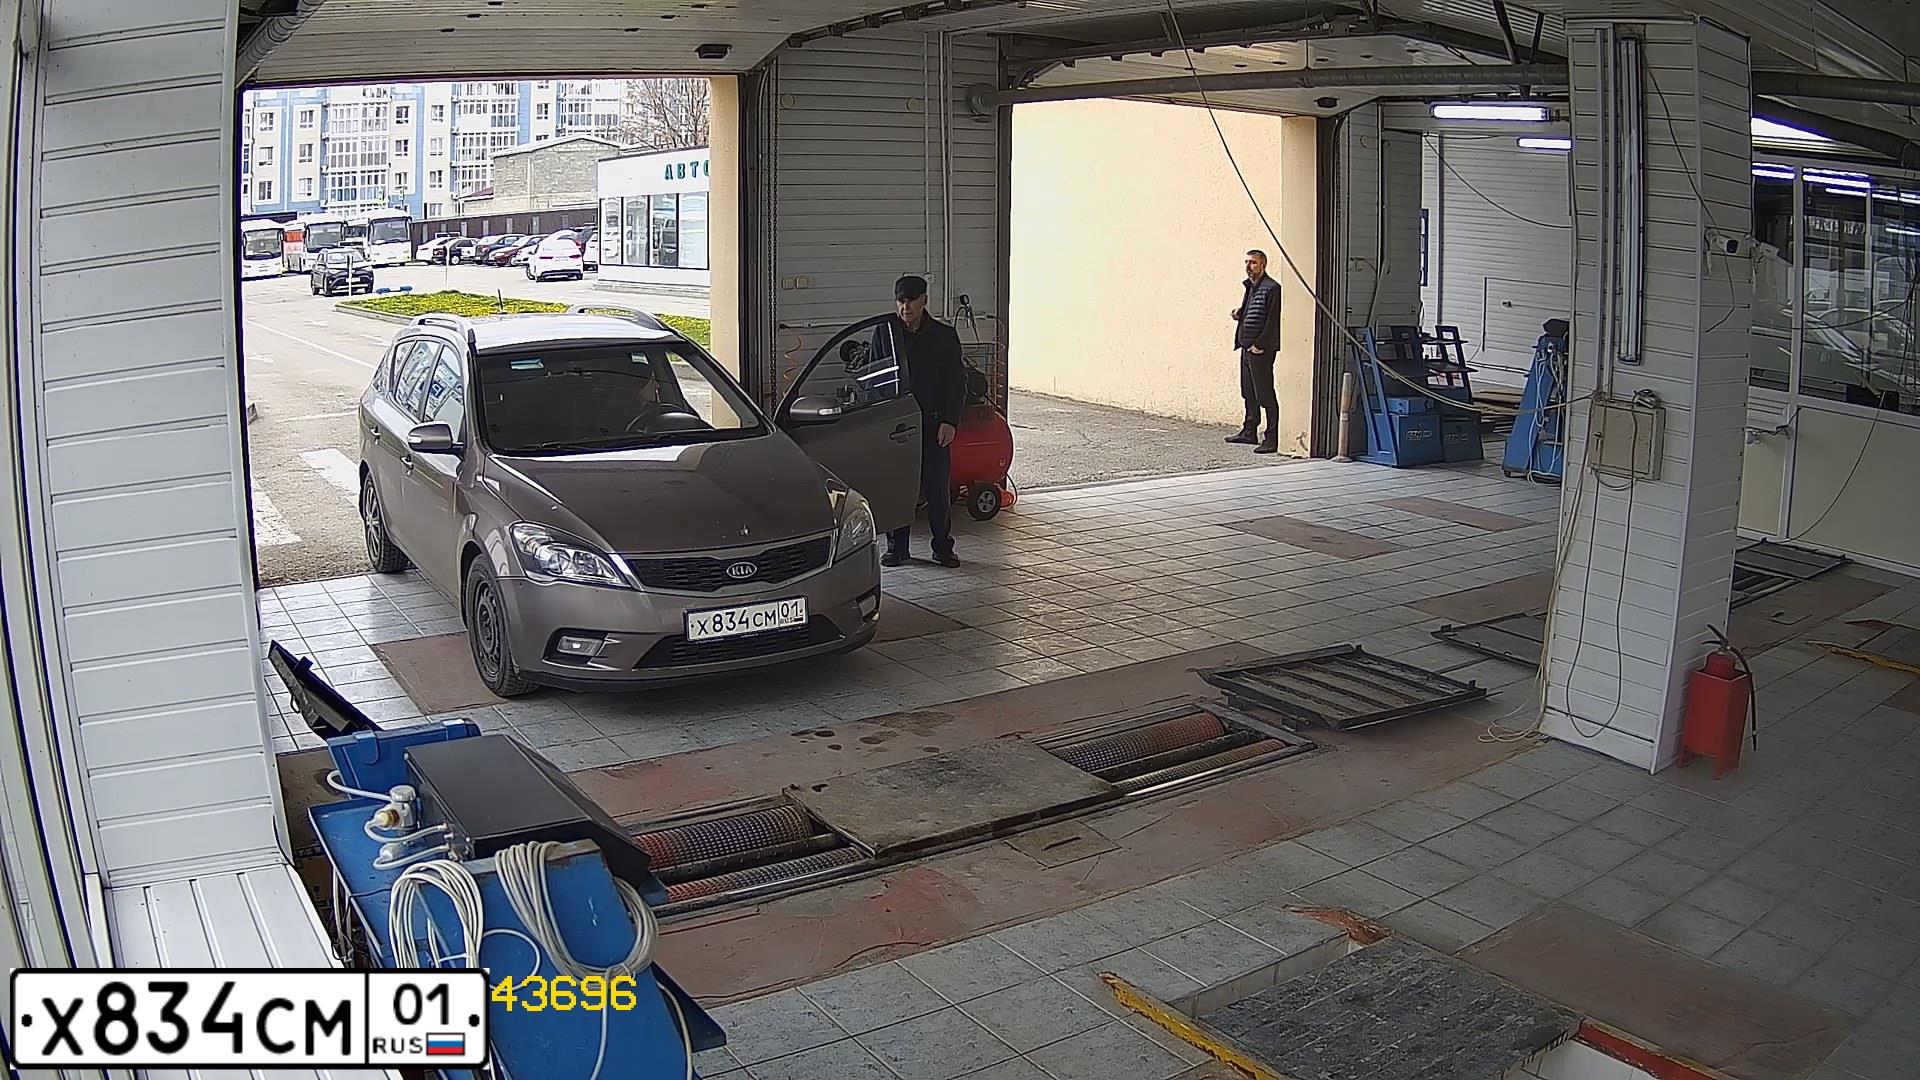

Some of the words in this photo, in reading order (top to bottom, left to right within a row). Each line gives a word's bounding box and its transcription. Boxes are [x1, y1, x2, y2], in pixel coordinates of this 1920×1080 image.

[731, 565, 753, 576] KIA
[696, 609, 777, 636] Х834СМ
[780, 600, 800, 618] 01
